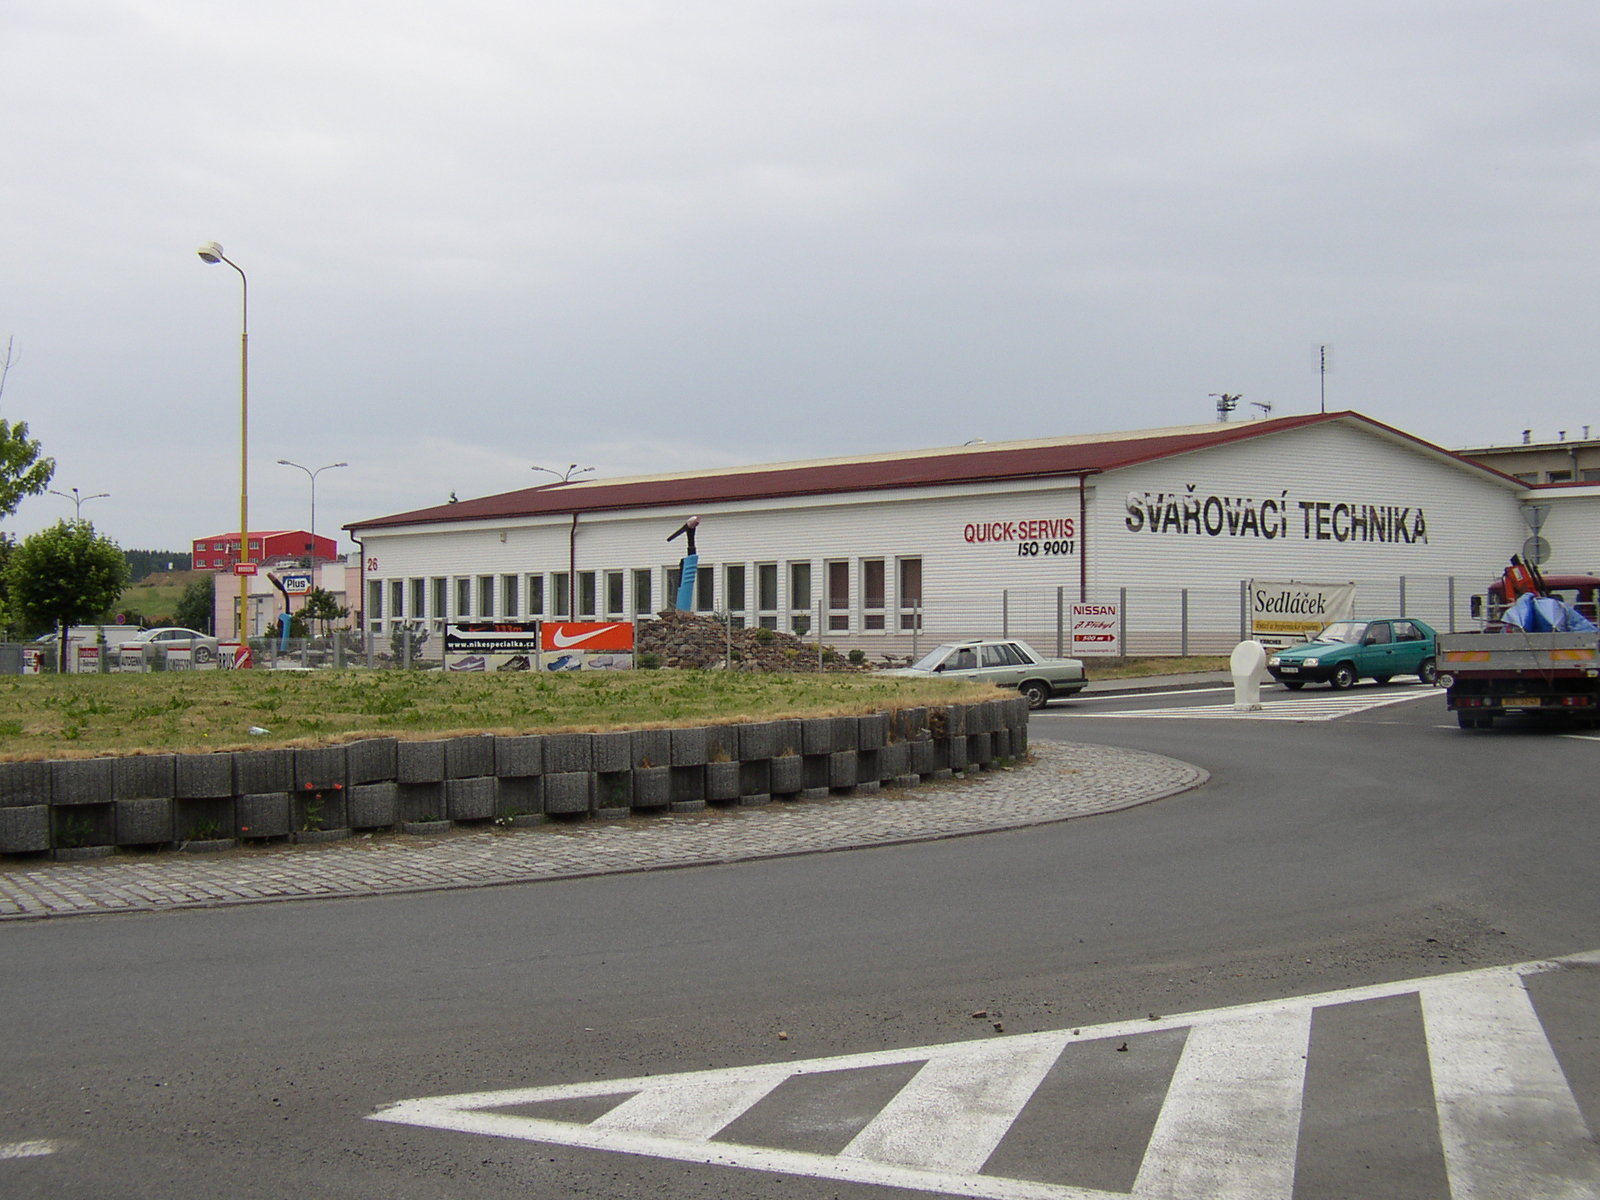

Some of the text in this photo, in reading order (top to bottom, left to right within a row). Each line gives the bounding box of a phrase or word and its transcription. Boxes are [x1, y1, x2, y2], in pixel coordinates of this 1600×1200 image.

[1125, 484, 1429, 545] SVAŘOVACÍ TECHNIKA
[964, 518, 1075, 543] QUICK-SERVIS
[1018, 540, 1074, 556] ISO 9001
[367, 558, 378, 572] 26
[287, 578, 306, 588] Plus
[1255, 590, 1327, 614] Sedláček
[1073, 605, 1116, 615] NISSAN
[448, 640, 535, 649] www.nikespecialka.cz
